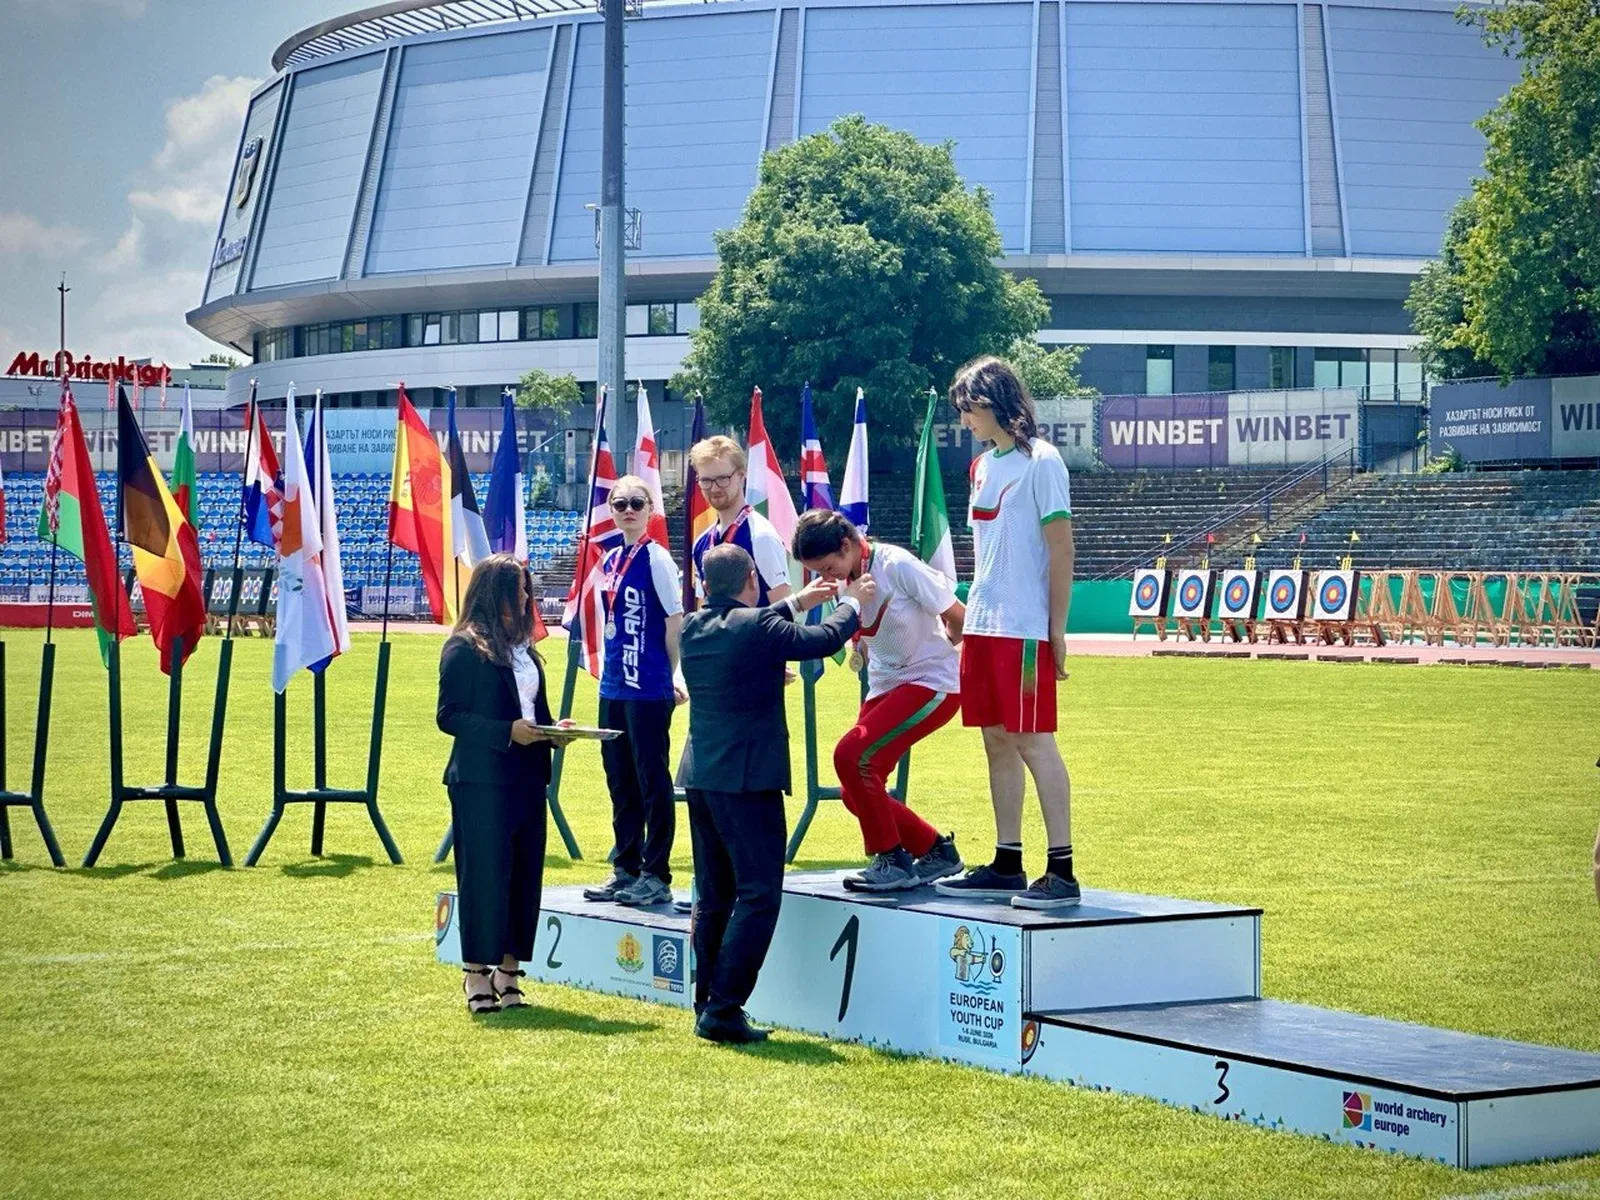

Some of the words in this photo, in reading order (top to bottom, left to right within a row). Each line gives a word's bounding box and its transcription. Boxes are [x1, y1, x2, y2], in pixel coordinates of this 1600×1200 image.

[1445, 408, 1481, 422] ХАЗАРТЪТ
[1482, 407, 1503, 419] НОСИ
[1504, 406, 1524, 418] РИСК
[1525, 405, 1536, 416] ОТ
[1560, 403, 1600, 430] WI
[361, 429, 381, 439] НОСИ
[1110, 418, 1223, 445] WINBET
[1236, 413, 1351, 442] WINBET
[1439, 424, 1478, 438] РАЗВИВАНЕ
[1479, 423, 1491, 435] НА
[1491, 420, 1542, 434] ЗАВИСИМОСТ
[84, 430, 175, 452] WINET
[358, 443, 369, 453] НА
[622, 585, 641, 690] ICELAND
[547, 915, 563, 969] 2
[830, 914, 860, 1023] 1
[950, 992, 1004, 1013] EUROPEAN
[950, 1009, 982, 1027] YOUTH
[984, 1015, 1004, 1030] CUP
[970, 1028, 982, 1037] JUNE
[973, 1037, 998, 1049] BULGARIA
[1213, 1060, 1230, 1105] 3
[1374, 1100, 1404, 1116] world
[1406, 1107, 1447, 1128] archery
[1374, 1118, 1410, 1136] europe
